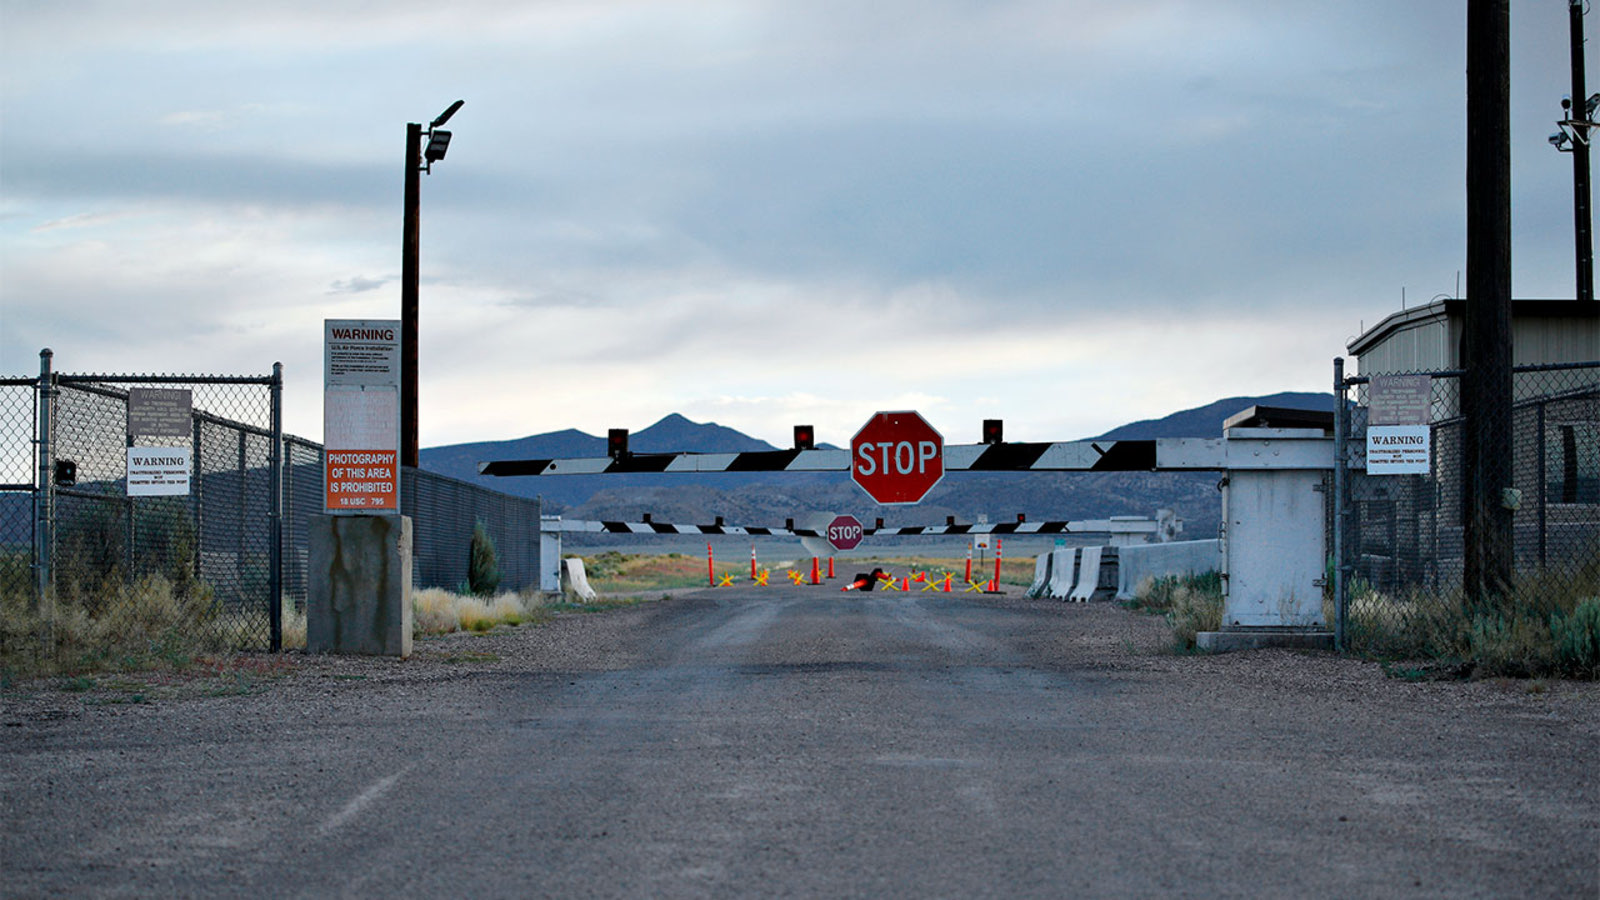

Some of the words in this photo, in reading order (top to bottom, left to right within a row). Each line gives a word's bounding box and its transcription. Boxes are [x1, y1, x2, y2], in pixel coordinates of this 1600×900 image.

[332, 328, 394, 341] WARNING
[1371, 435, 1424, 445] WARNING
[132, 456, 185, 466] WARNING
[328, 453, 395, 465] PHOTOGRAPHY
[858, 440, 937, 476] STOP
[332, 467, 344, 479] OF
[346, 467, 366, 479] THIS
[367, 467, 392, 479] AREA
[330, 482, 340, 493] IS
[341, 482, 393, 493] PROHIBITED
[340, 497, 349, 506] 18
[350, 497, 366, 506] USC
[371, 497, 385, 506] 795
[830, 526, 861, 540] STOP
